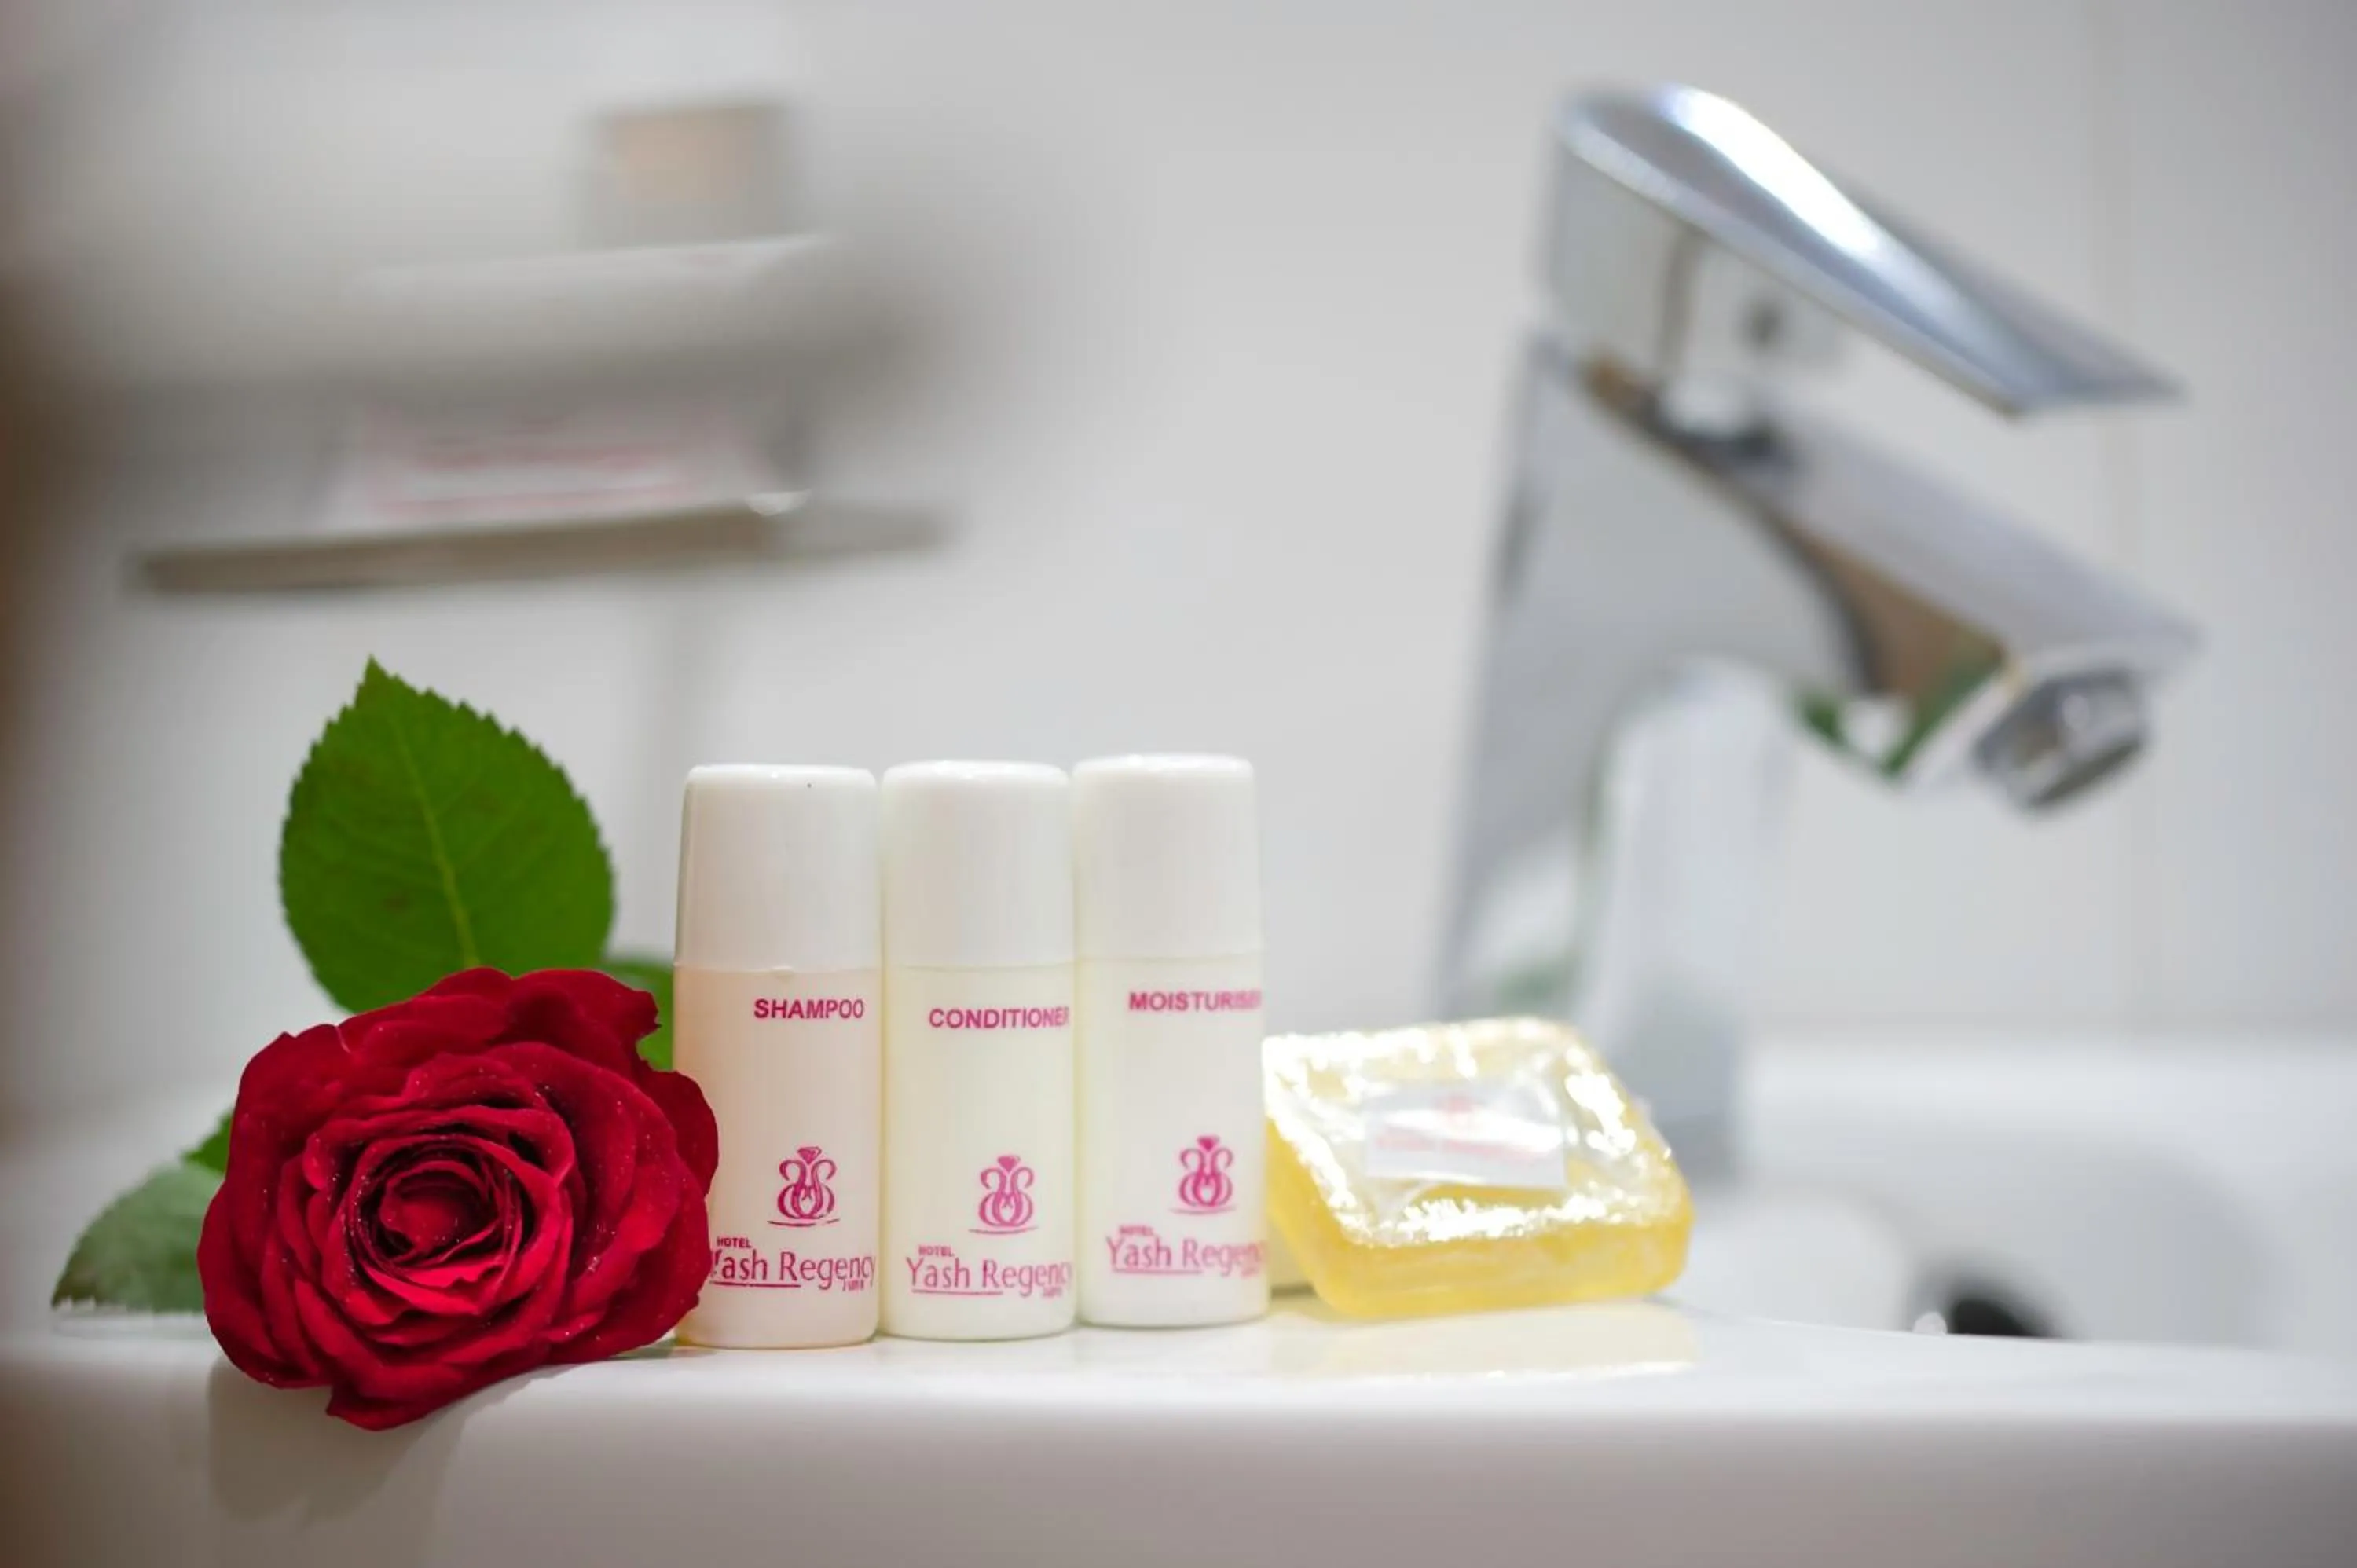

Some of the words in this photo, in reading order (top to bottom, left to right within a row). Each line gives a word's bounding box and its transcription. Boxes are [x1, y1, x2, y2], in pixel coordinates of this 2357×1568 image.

[753, 998, 864, 1019] SHAMPOO
[717, 1236, 752, 1249] HOTEL
[918, 1244, 955, 1258] HOTEL
[1105, 1235, 1172, 1268] Yash
[779, 1251, 875, 1291] Regency
[906, 1256, 970, 1288] Yash
